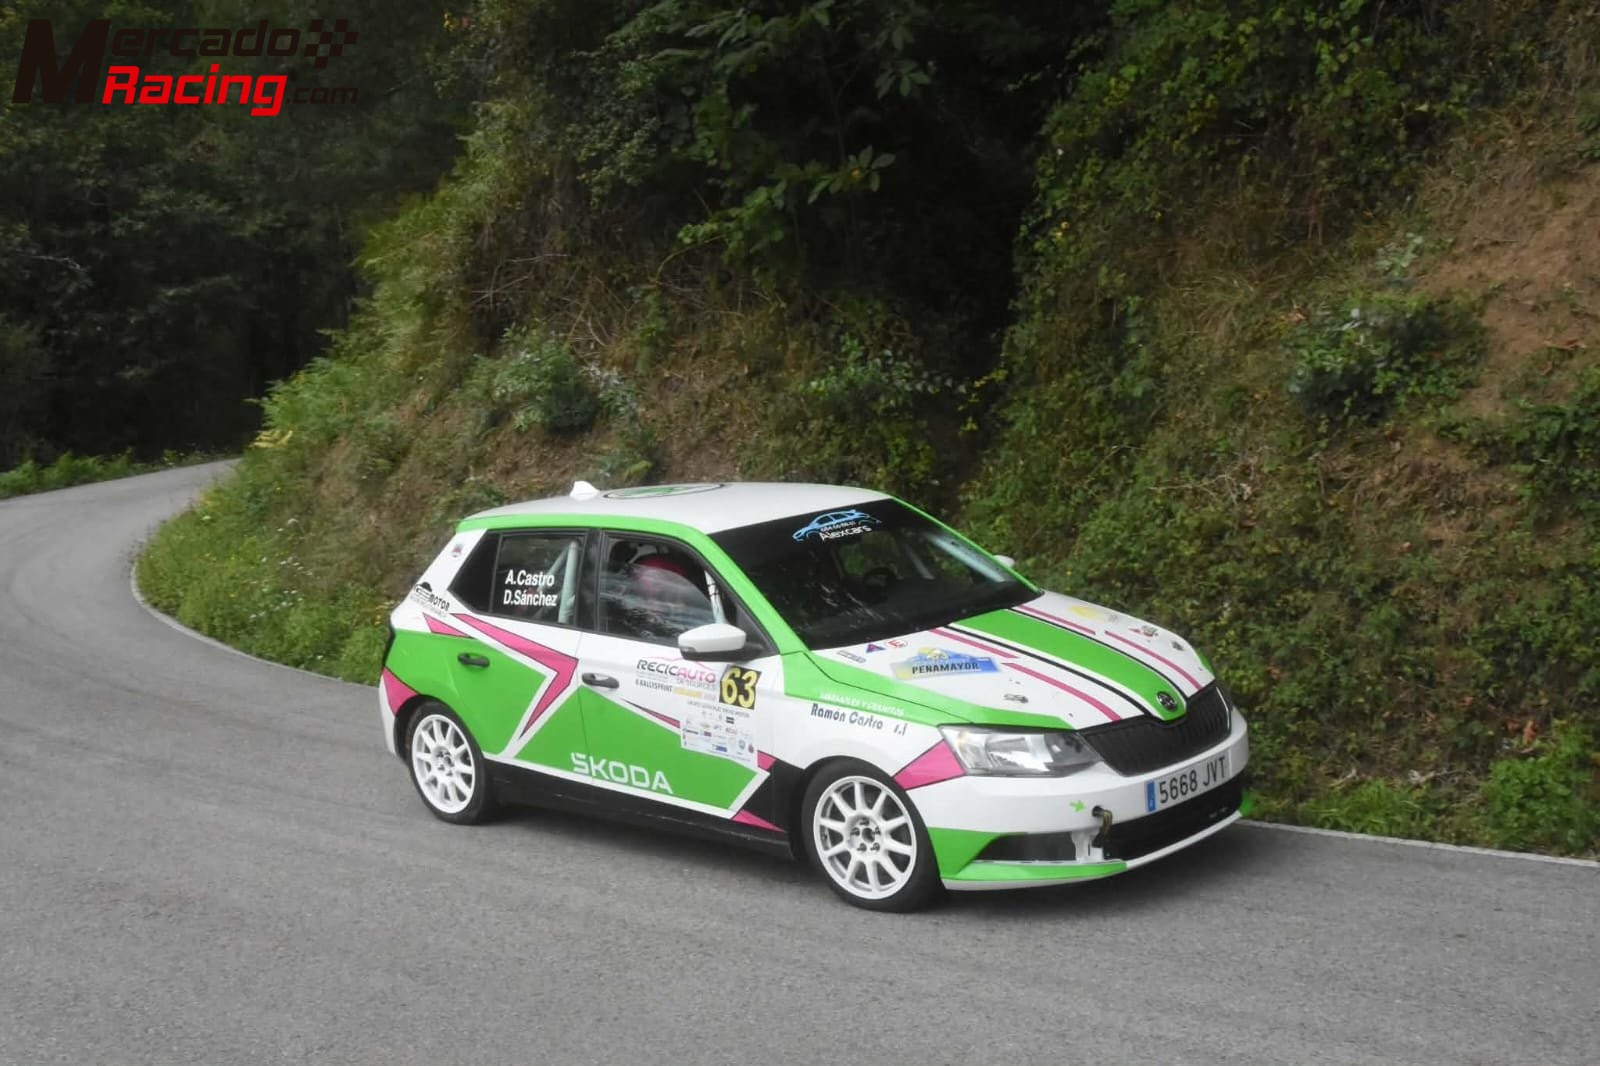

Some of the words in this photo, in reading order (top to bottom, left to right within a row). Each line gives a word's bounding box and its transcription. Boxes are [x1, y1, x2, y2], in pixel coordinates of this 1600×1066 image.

[505, 569, 555, 587] A.Castro
[503, 588, 558, 607] D.Sánchez
[721, 667, 758, 709] 63
[849, 711, 883, 730] Castro
[1159, 769, 1198, 804] 5668
[1203, 755, 1226, 786] JVT
